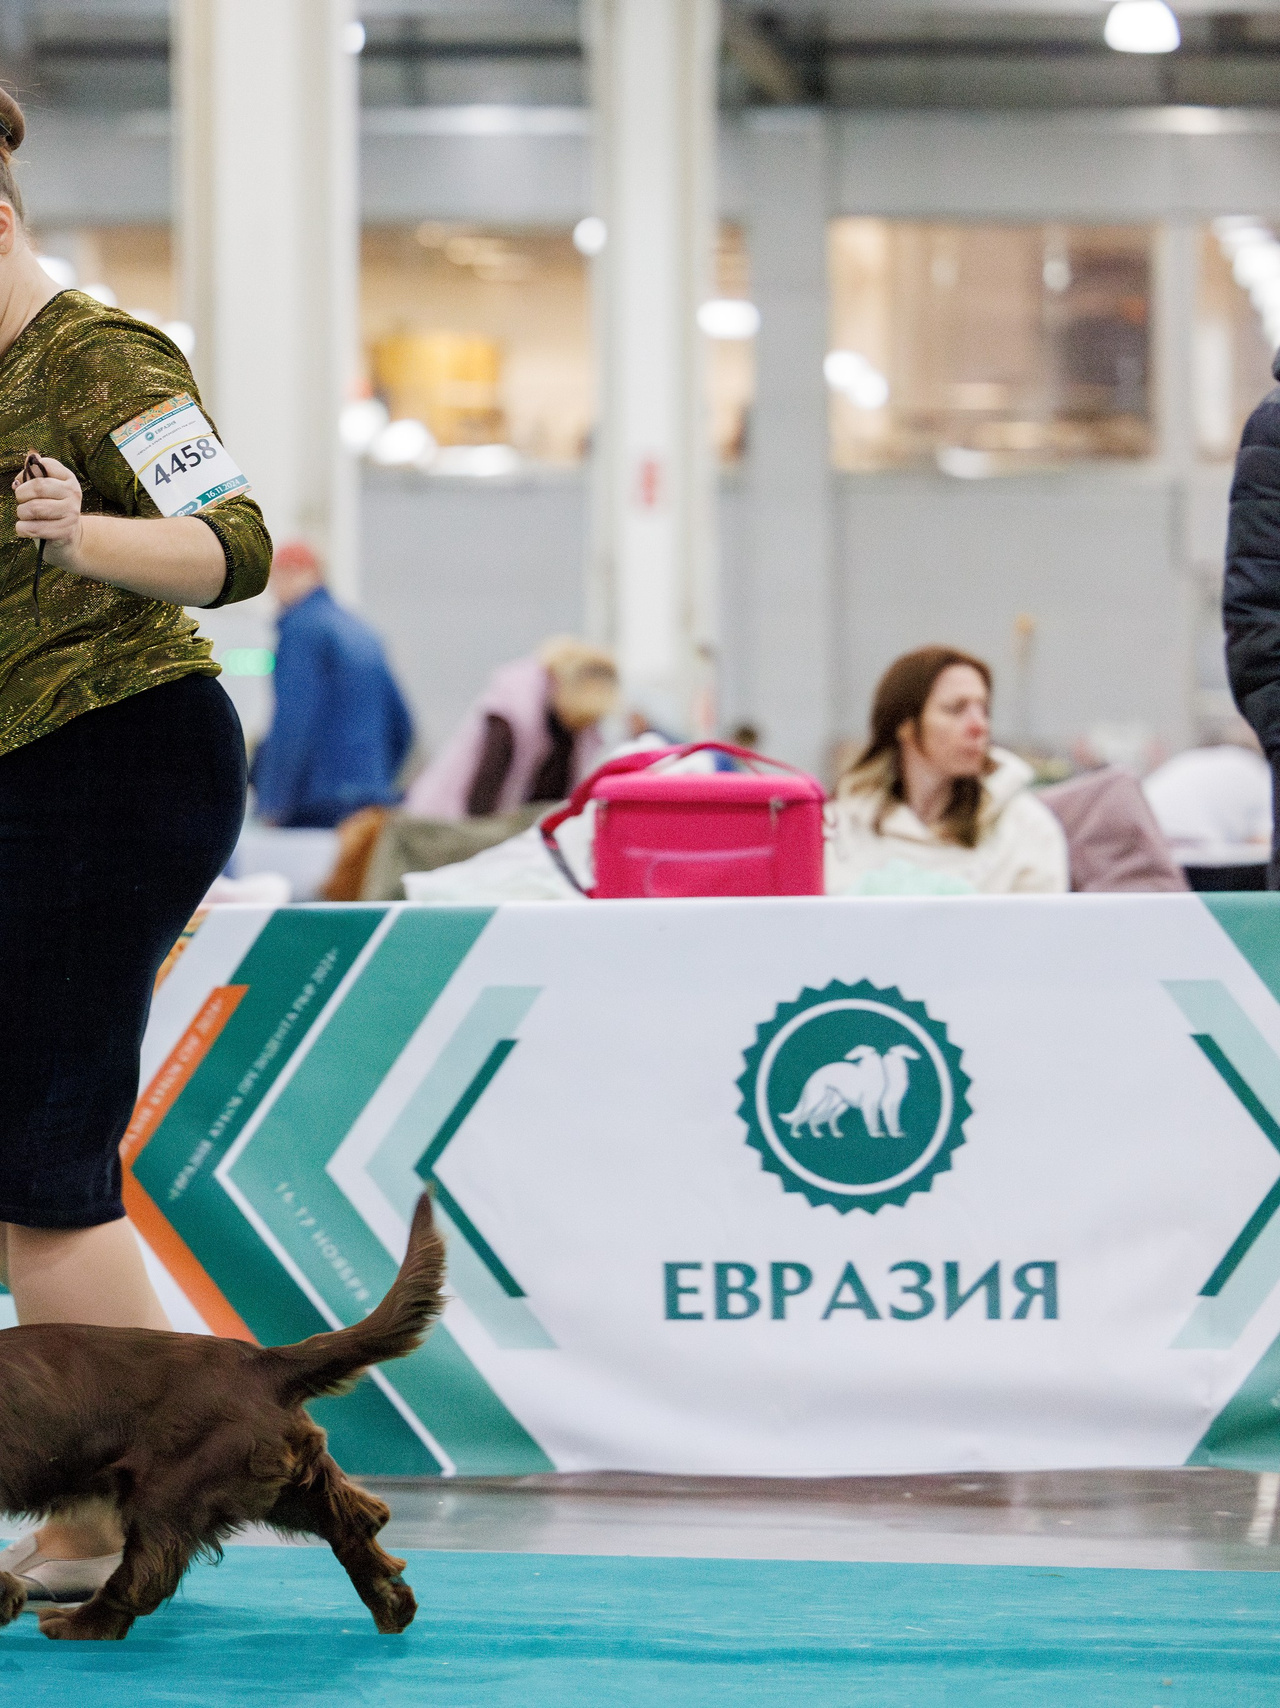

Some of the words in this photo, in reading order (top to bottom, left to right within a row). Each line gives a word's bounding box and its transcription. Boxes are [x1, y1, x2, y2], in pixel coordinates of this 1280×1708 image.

[155, 438, 217, 486] 4458
[205, 479, 240, 499] 16.11.2024
[662, 1259, 1059, 1321] ЕВРАЗИЯ
